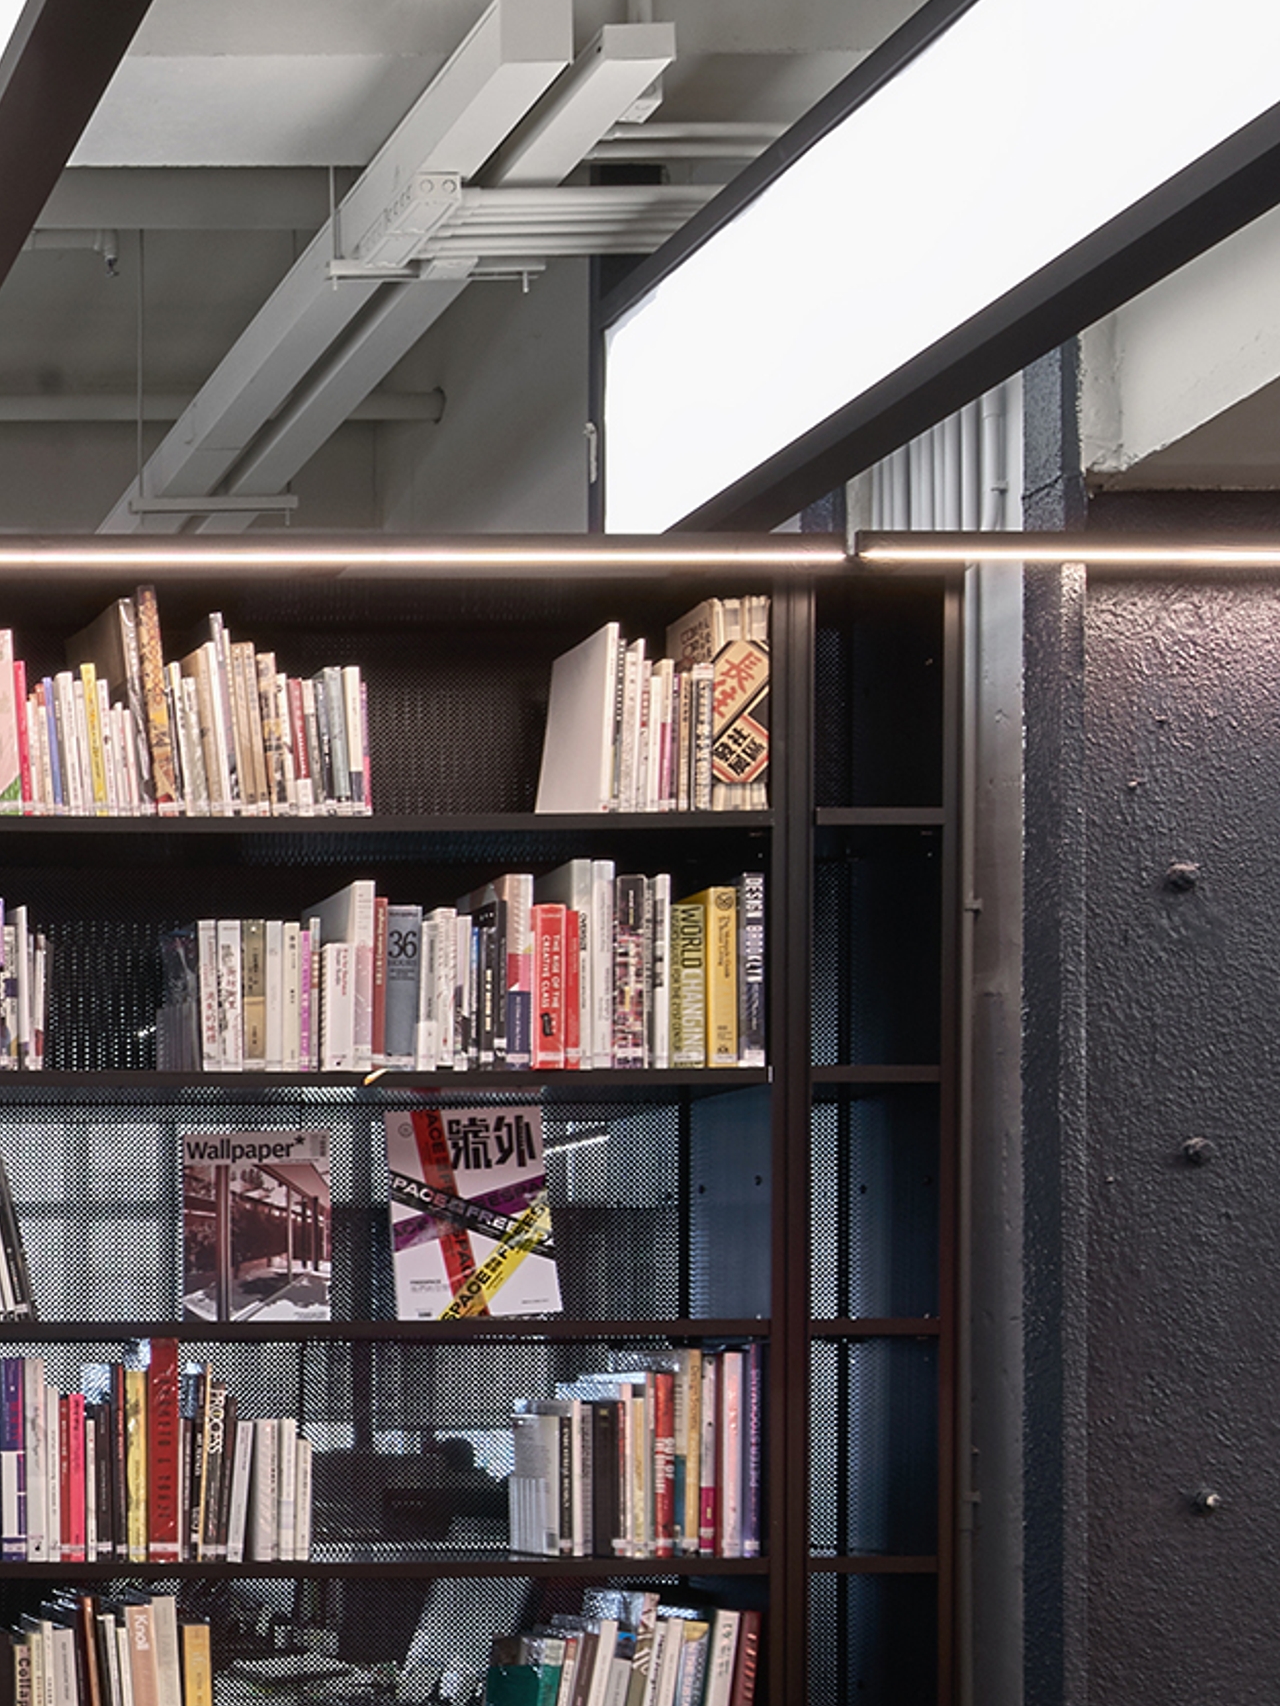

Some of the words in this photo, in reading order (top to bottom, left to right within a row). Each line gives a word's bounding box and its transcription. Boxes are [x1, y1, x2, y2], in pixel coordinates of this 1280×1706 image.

[745, 877, 764, 918] DESIGN
[388, 930, 418, 959] 36
[541, 934, 550, 978] CREATIVE
[552, 934, 560, 953] THE
[745, 924, 764, 983] BROOKLYN
[552, 955, 560, 974] RISE
[541, 980, 550, 1008] CLASS
[552, 975, 560, 989] OF
[552, 991, 560, 1008] THE
[207, 1388, 226, 1455] PROCESS
[749, 1368, 761, 1442] STOCKMANS
[132, 1612, 151, 1651] Knoll
